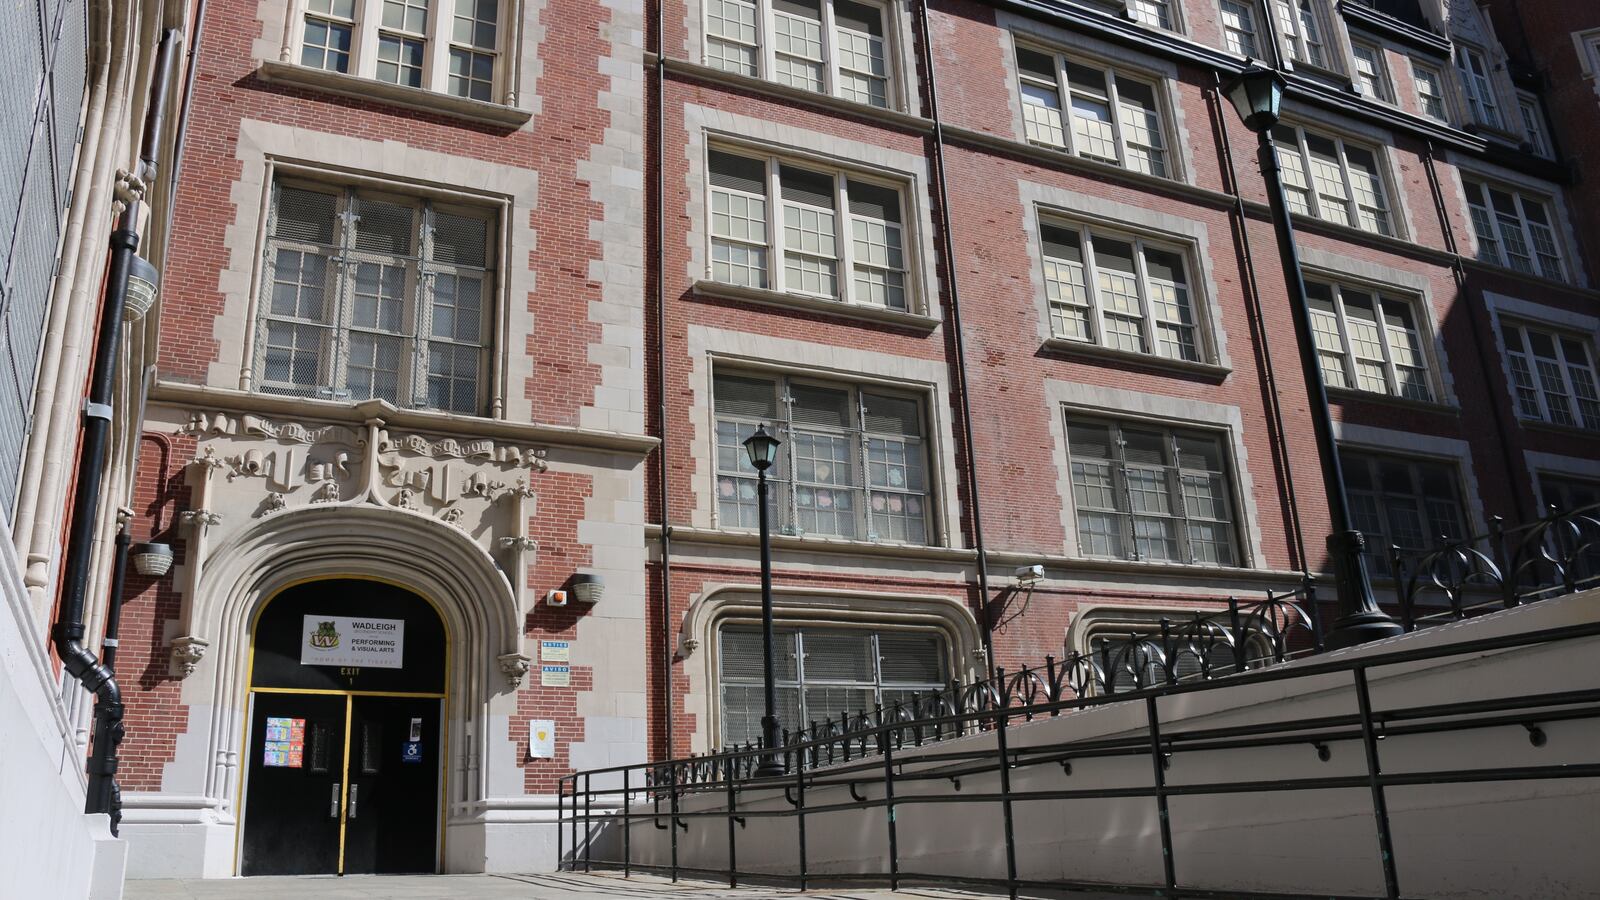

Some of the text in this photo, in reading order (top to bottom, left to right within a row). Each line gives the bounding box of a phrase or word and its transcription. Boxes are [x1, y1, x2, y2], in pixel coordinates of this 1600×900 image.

[352, 622, 396, 630] WADLEIGH
[351, 638, 396, 646] PERFORMING
[340, 667, 360, 676] EXIT
